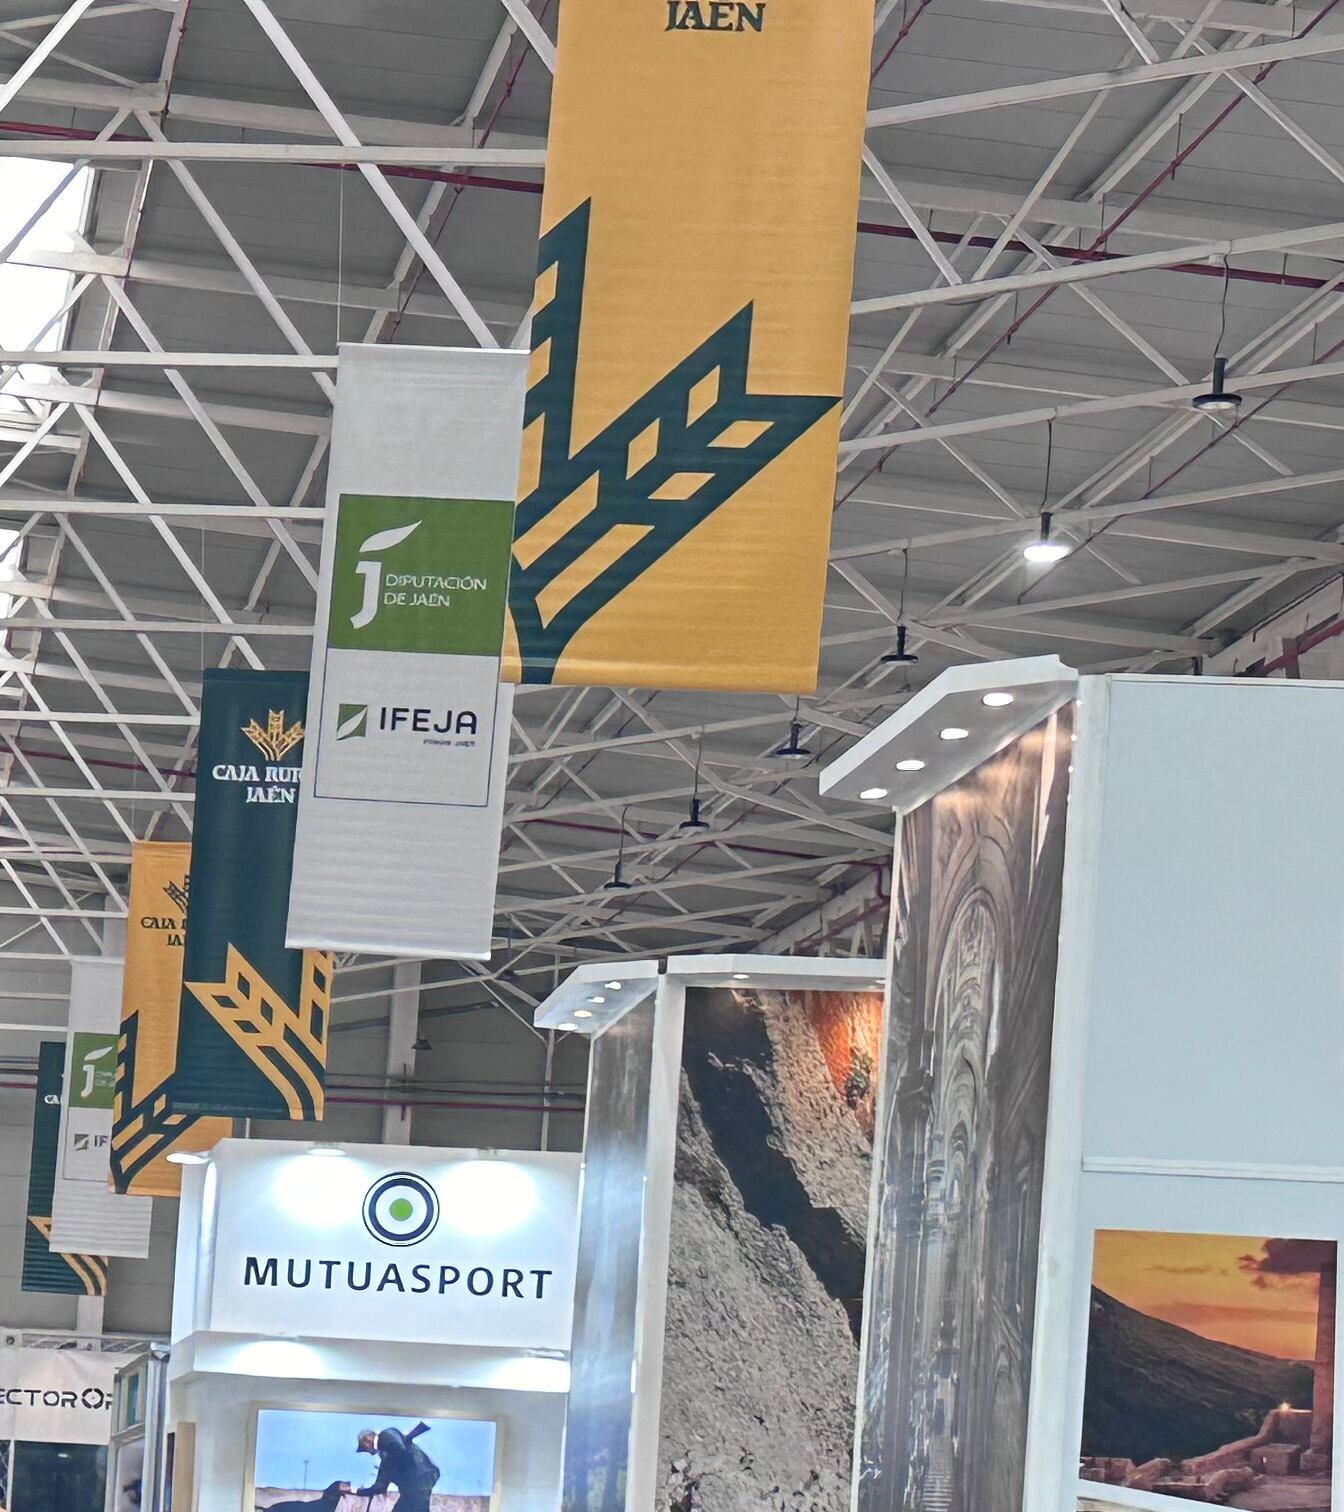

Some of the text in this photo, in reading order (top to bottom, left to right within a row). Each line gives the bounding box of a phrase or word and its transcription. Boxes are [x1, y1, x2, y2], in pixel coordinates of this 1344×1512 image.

[383, 592, 407, 605] DE
[380, 707, 478, 734] IFEJA
[212, 765, 260, 782] CAJA
[244, 1256, 552, 1299] MUTUASPORT
